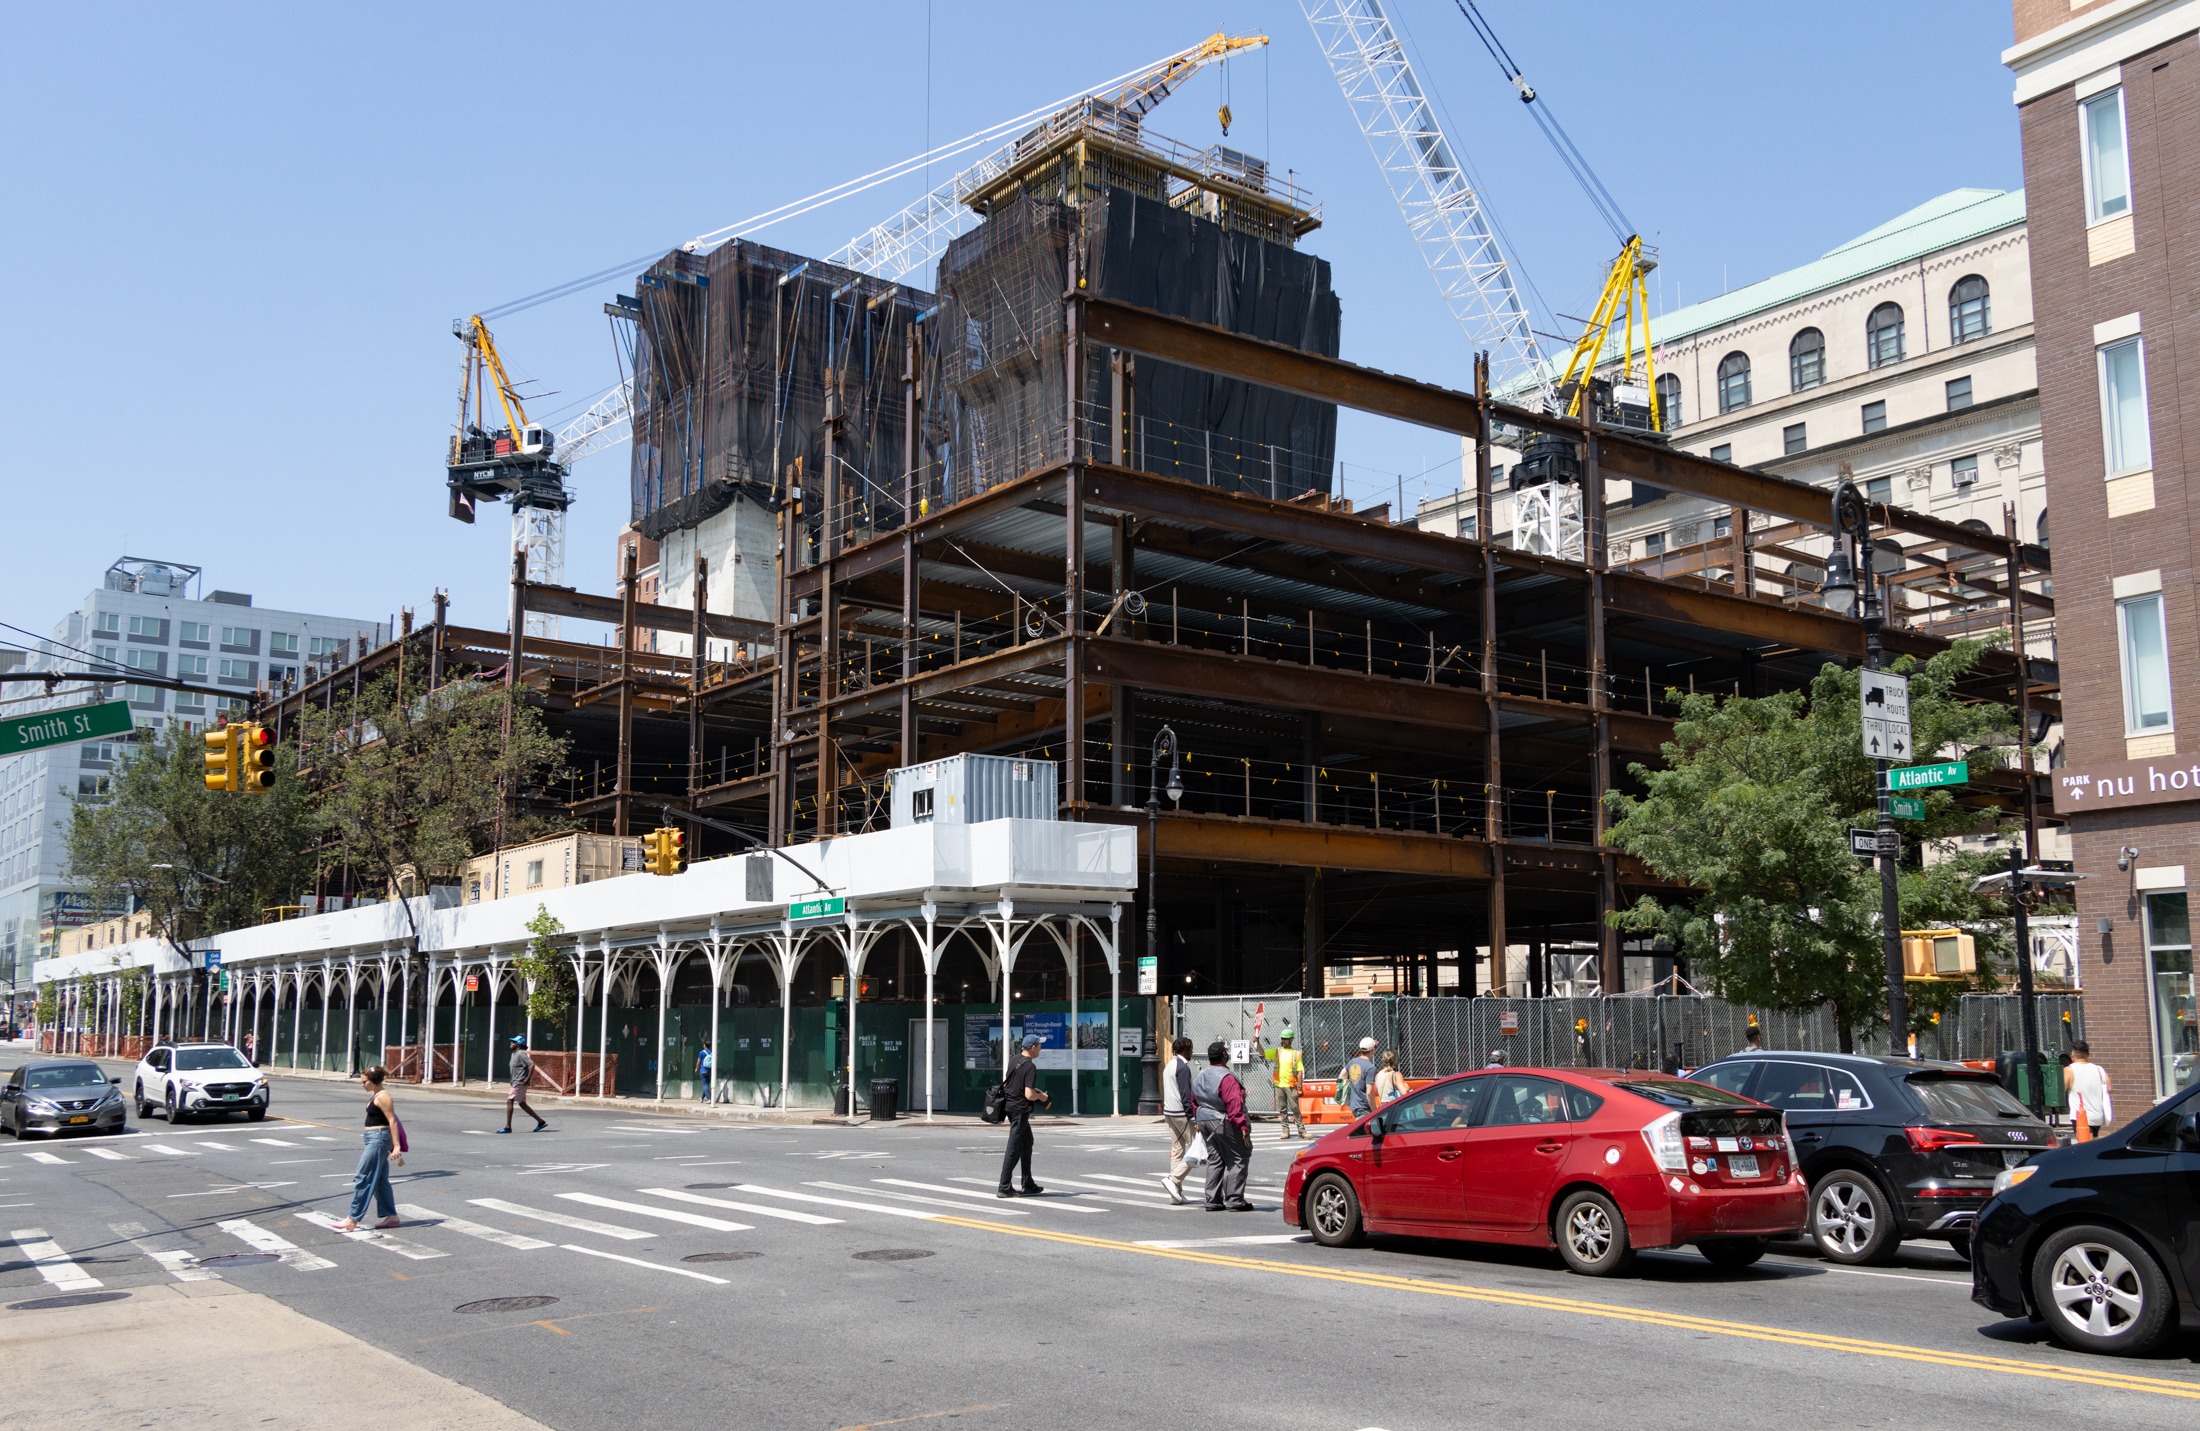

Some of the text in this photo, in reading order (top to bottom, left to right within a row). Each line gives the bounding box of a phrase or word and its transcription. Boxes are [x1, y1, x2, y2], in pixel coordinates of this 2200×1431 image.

[1885, 686, 1904, 698] TRUCK
[1887, 704, 1906, 716] ROUTE
[18, 714, 91, 744] Smith St
[1866, 720, 1882, 732] THRU
[1888, 724, 1908, 736] LOCAL
[1899, 766, 1956, 787] Atlantic Av
[2062, 774, 2090, 787] PARK
[2097, 765, 2200, 798] nu hot
[1894, 801, 1919, 816] Smith St
[1858, 838, 1873, 849] ONE
[58, 894, 124, 908] Maralls
[802, 902, 832, 914] Atlantic Av
[1254, 1012, 1264, 1026] STOP
[1237, 1050, 1243, 1060] 4
